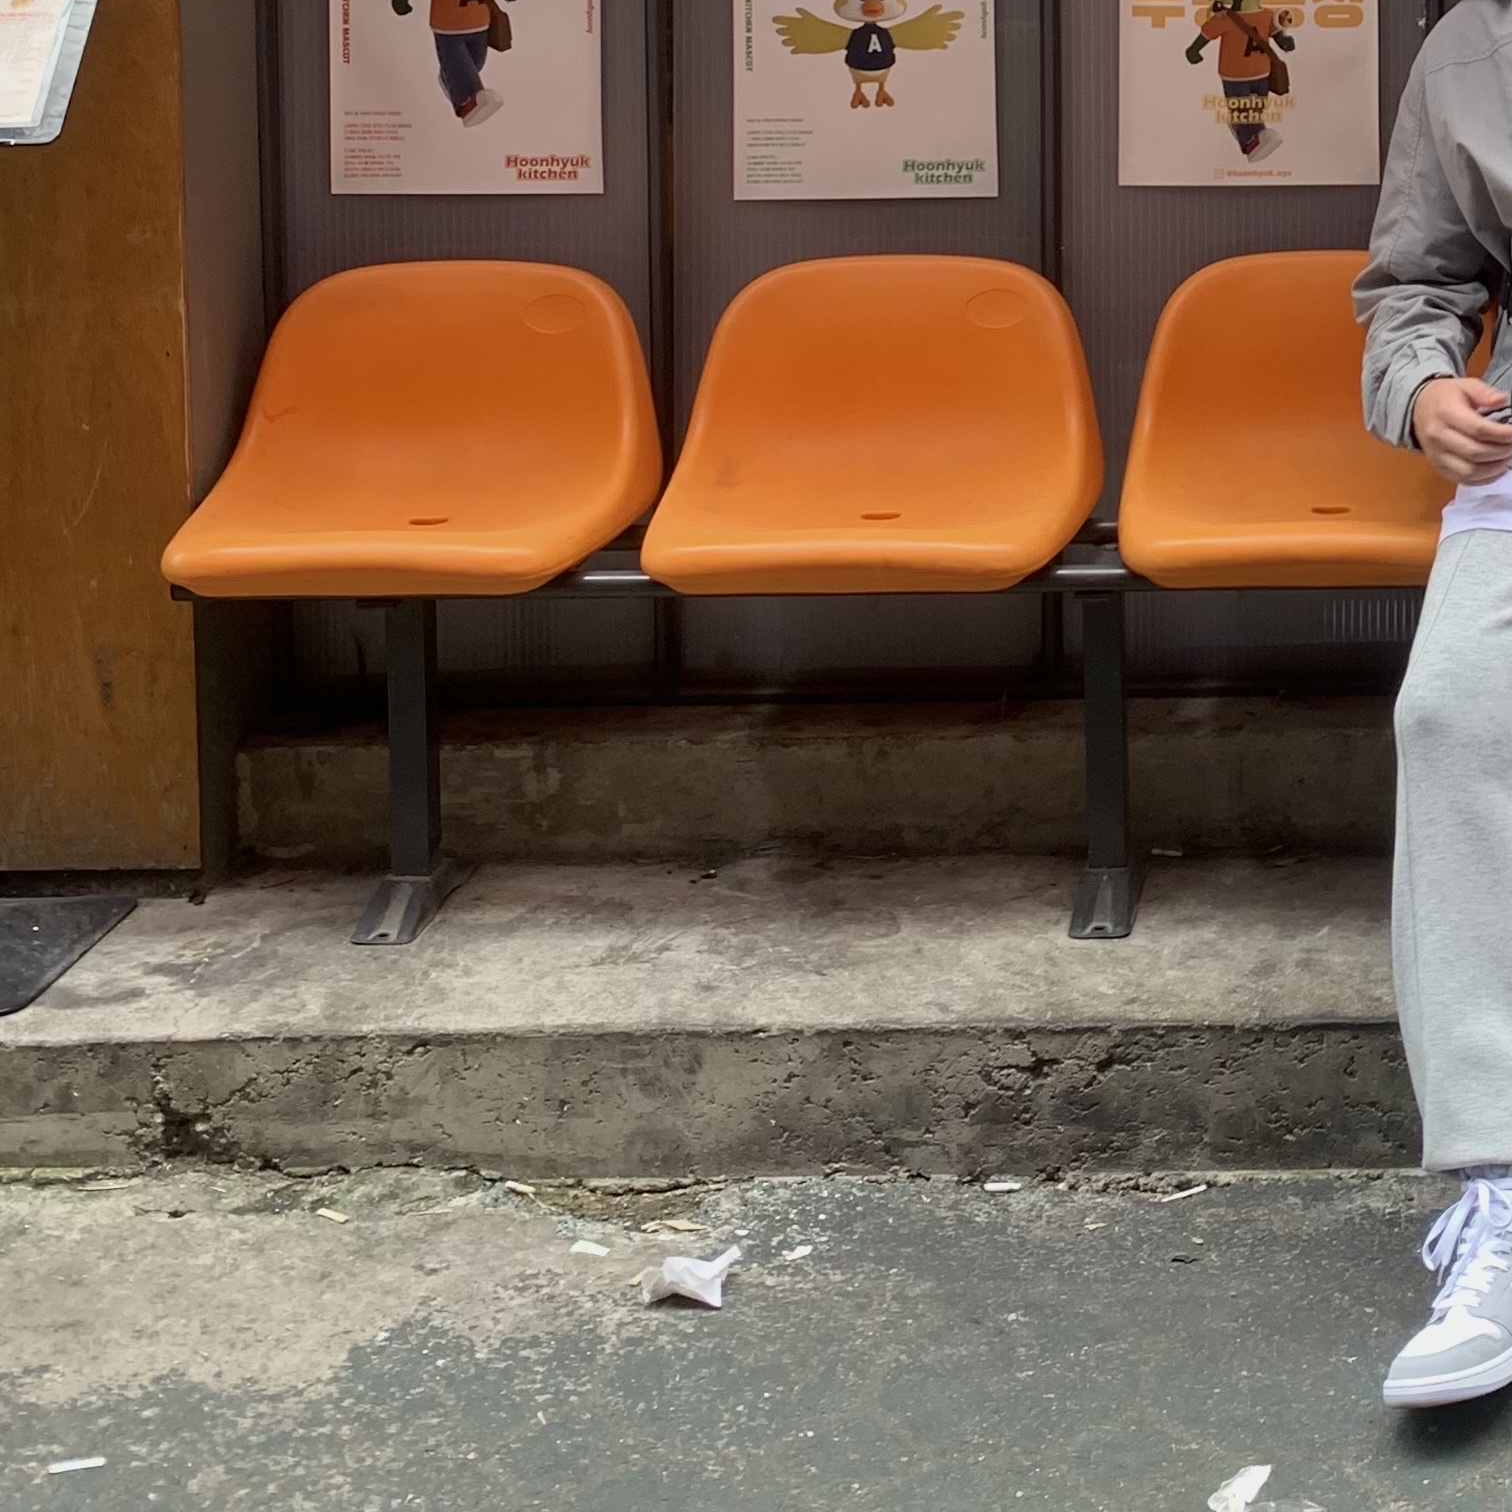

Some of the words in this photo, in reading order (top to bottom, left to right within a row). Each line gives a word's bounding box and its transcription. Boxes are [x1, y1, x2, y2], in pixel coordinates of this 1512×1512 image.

[342, 27, 350, 64] MASCOT
[867, 34, 883, 54] A
[745, 36, 753, 72] MASCOT
[1203, 94, 1296, 111] Hoonhyuk
[1215, 108, 1284, 124] kitchen
[505, 155, 591, 170] Hoonhyuk
[902, 159, 985, 175] Hoonhyuk
[517, 167, 579, 180] kitchen
[914, 171, 974, 184] kitchen
